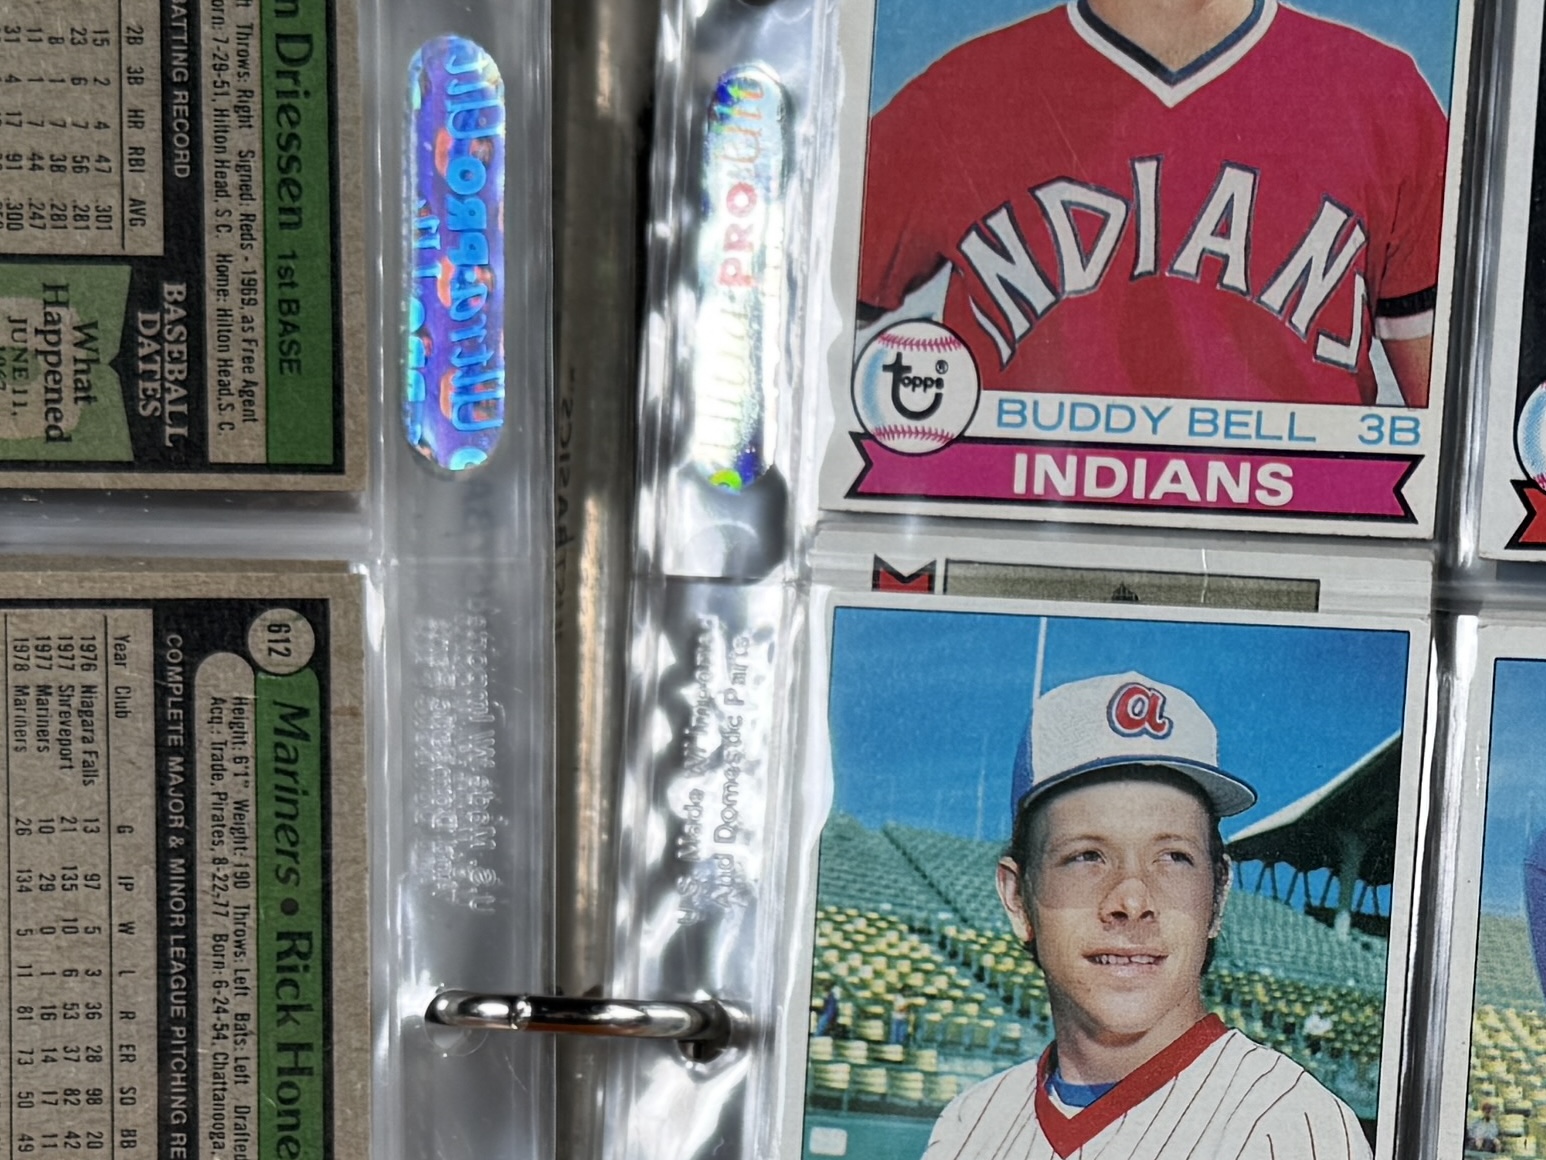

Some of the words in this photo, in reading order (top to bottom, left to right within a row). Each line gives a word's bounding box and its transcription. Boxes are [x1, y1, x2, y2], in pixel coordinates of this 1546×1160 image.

[236, 23, 254, 82] Throws:
[174, 91, 190, 178] RECORD
[234, 90, 254, 129] Right
[275, 32, 314, 231] Driessen
[236, 150, 255, 206] Signed:
[240, 213, 256, 250] Reds
[717, 183, 758, 288] PRO
[240, 270, 258, 310] 1969,
[277, 250, 298, 289] 1st
[8, 316, 28, 380] JUNE
[241, 316, 253, 332] as
[278, 298, 302, 376] BASE
[35, 282, 72, 444] Happened
[73, 321, 100, 405] What
[138, 312, 160, 417] DATES
[163, 282, 188, 447] BASEBALL
[242, 339, 258, 374] Free
[882, 351, 945, 420] topps
[239, 380, 258, 423] Agent
[997, 398, 1173, 437] BUDDY
[1188, 407, 1317, 444] BELL
[1359, 413, 1421, 447] 3B
[1012, 454, 1295, 507] INDIANS
[267, 624, 292, 658] 612
[167, 634, 184, 746] COMPLETE
[229, 696, 249, 750] Height:
[168, 756, 184, 828] MAJOR
[210, 792, 228, 851] Pirates,
[272, 700, 312, 886] Mariners
[169, 836, 184, 848] &
[230, 800, 250, 856] Weight:
[170, 858, 186, 926] MINOR
[212, 857, 228, 917] 8-22-77
[234, 863, 250, 888] 190
[212, 934, 228, 974] Born:
[234, 904, 250, 962] Throws:
[170, 935, 186, 1018] LEAGUE
[234, 970, 250, 996] Left
[275, 931, 314, 1028] Rick
[234, 1013, 250, 1050] Bats:
[170, 1026, 186, 1124] PITCHING
[234, 1057, 250, 1084] Left
[209, 1052, 229, 1154] Chattanooga,
